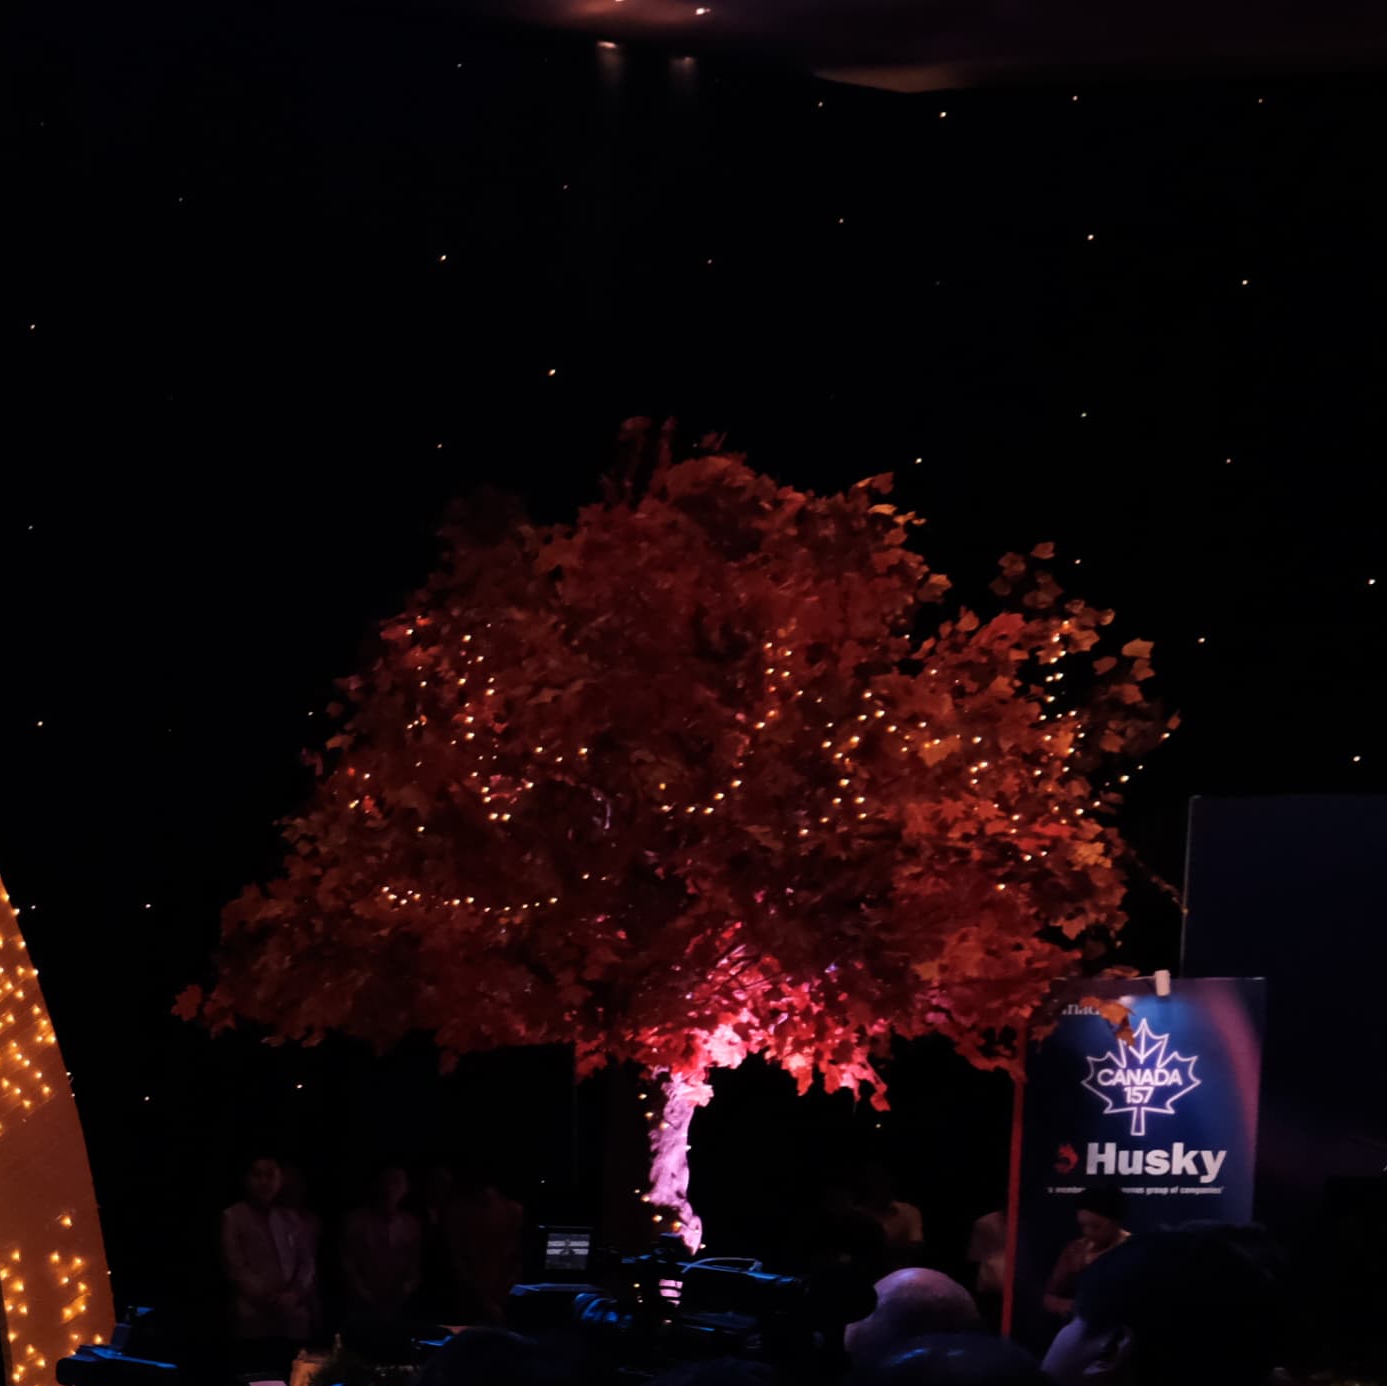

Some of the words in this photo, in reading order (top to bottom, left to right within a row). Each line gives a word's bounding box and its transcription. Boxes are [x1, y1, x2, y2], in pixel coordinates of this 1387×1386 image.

[1097, 1068, 1184, 1087] CANADA
[1123, 1086, 1155, 1104] 157
[1086, 1142, 1227, 1183] Husky
